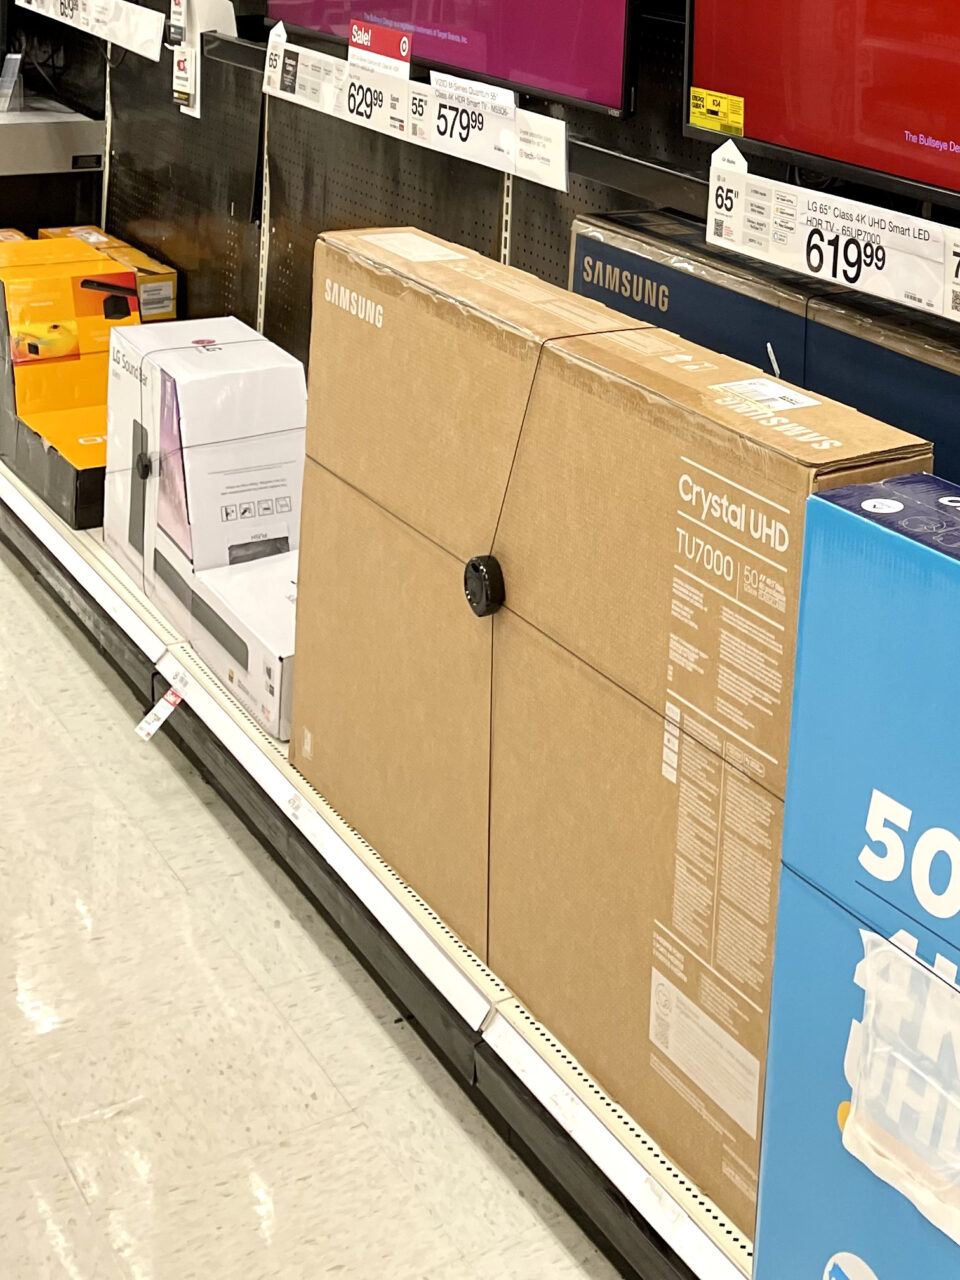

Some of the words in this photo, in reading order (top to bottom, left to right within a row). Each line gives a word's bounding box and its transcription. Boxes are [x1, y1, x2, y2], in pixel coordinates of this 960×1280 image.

[352, 25, 372, 46] Sale!
[904, 131, 918, 143] The
[918, 134, 948, 151] Bullseye
[806, 216, 824, 231] HDR
[825, 220, 835, 232] TV
[807, 200, 817, 212] LG
[833, 206, 854, 222] Class
[855, 213, 868, 225] 4K
[868, 216, 887, 231] UHD
[888, 220, 910, 237] Smart
[912, 228, 930, 242] LED
[323, 277, 384, 329] SAMSUNG
[582, 255, 670, 313] SAMSUNG
[112, 347, 121, 365] LG
[678, 474, 746, 532] Crystal
[749, 512, 789, 553] UHD
[676, 527, 734, 582] TU7000
